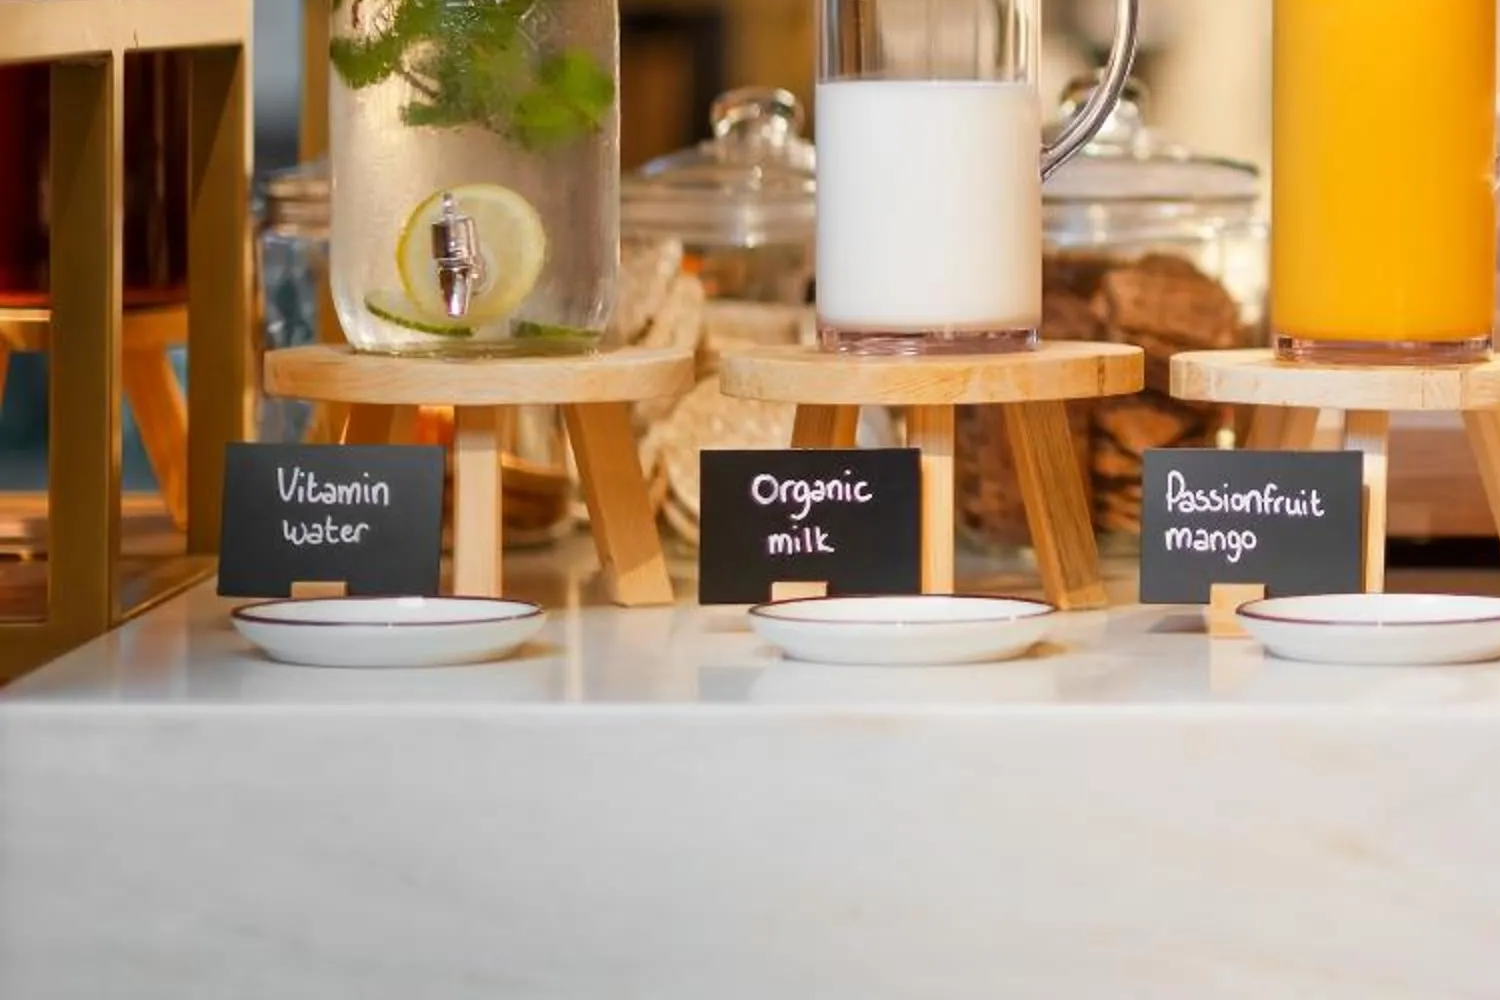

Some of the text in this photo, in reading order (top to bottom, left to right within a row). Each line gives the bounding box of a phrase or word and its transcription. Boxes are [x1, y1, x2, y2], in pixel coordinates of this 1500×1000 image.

[277, 467, 390, 507] Vitamin
[750, 469, 873, 522] Organic
[1164, 469, 1325, 518] Passionfruit
[282, 515, 370, 545] water
[767, 525, 836, 555] milk
[1163, 525, 1258, 565] mango
